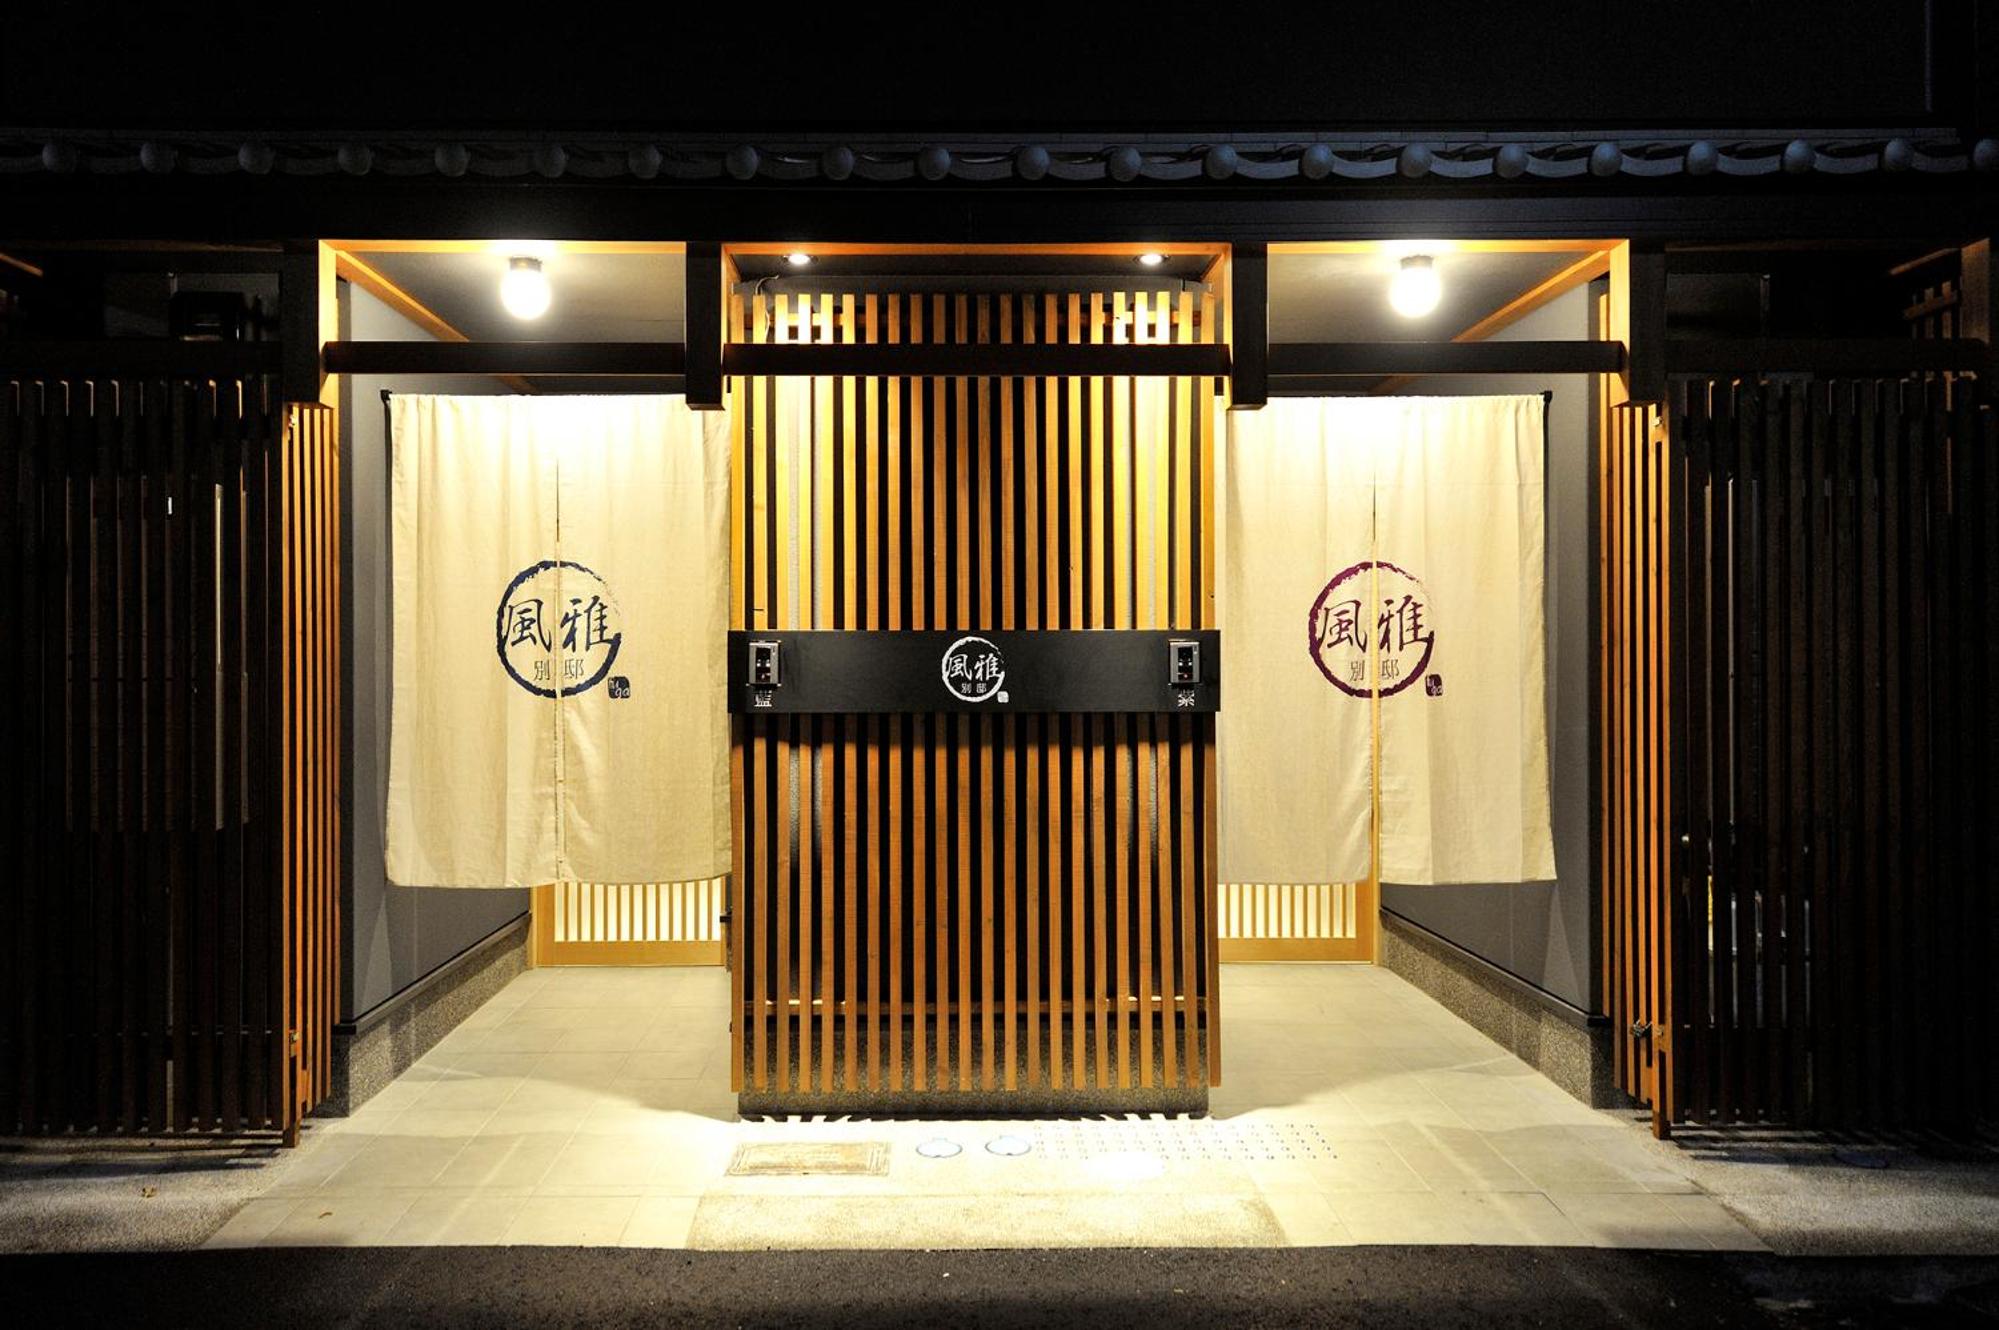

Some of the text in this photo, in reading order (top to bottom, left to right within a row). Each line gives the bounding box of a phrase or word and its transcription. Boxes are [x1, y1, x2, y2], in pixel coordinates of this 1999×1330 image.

[504, 594, 617, 653] 風雅
[1319, 594, 1431, 653] 風雅
[533, 658, 585, 681] 別邸
[946, 653, 1002, 681] 風雅
[1350, 658, 1400, 682] 別邸
